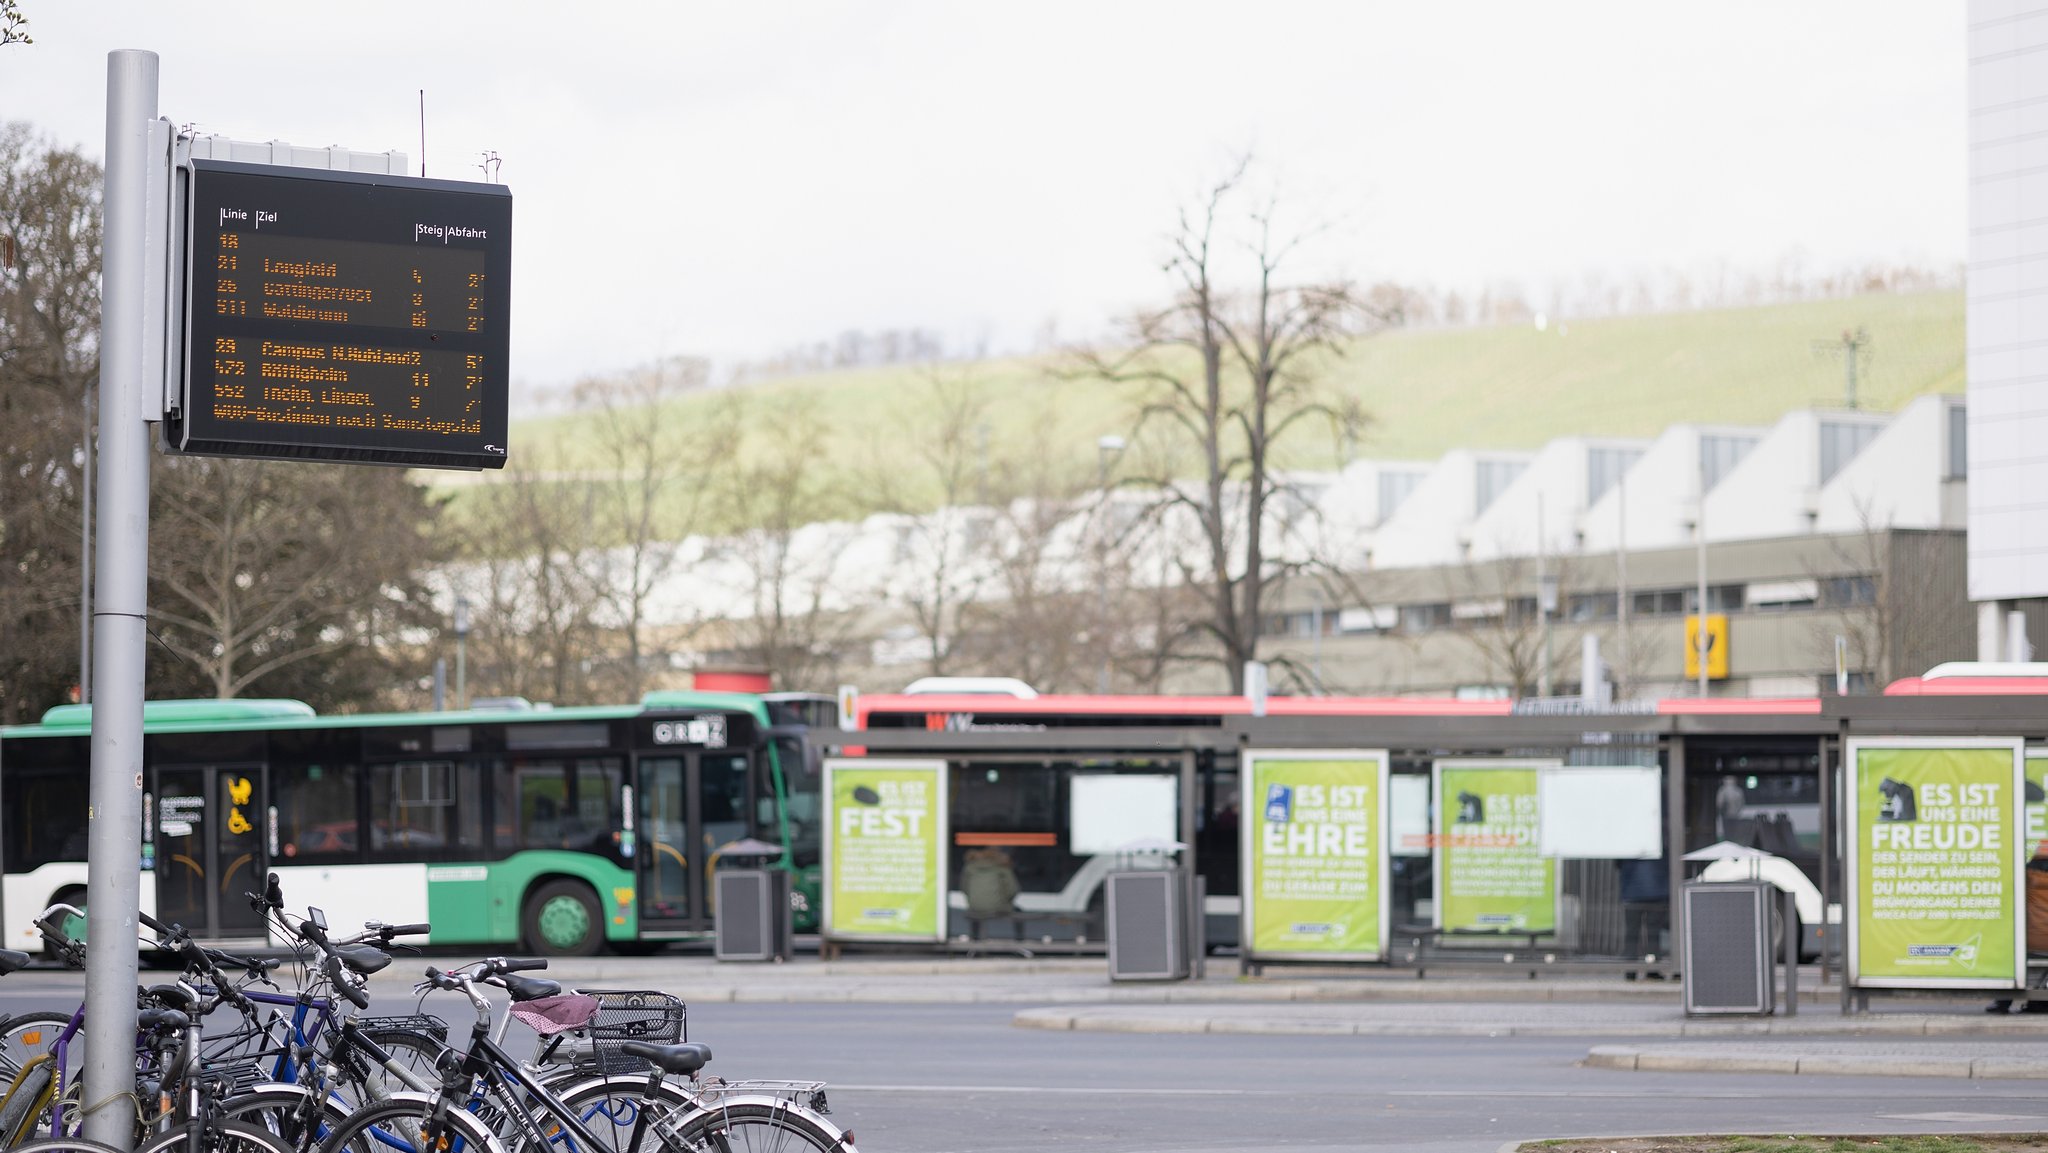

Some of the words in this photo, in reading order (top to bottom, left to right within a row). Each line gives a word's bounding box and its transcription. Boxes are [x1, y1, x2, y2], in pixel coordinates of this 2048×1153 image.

[223, 208, 247, 220] Linie
[258, 211, 277, 222] Ziel
[418, 223, 443, 237] Steig
[447, 227, 487, 239] Abfahrt
[218, 255, 237, 270] 21
[262, 341, 325, 360] Campus
[412, 372, 429, 387] 11
[1295, 784, 1325, 807] ES
[1331, 785, 1368, 808] IST
[1920, 783, 1953, 806] ES
[1959, 784, 2000, 807] IST
[841, 808, 926, 836] FEST
[1921, 807, 1957, 822] UNS
[1961, 807, 2000, 822] EINE
[1263, 823, 1369, 856] EHRE
[1872, 824, 2002, 850] FREUDE
[1872, 881, 1894, 895] DU
[1896, 881, 1970, 895] MORGENS
[1971, 881, 2003, 895] DEN
[495, 1082, 541, 1144] HERCULES
